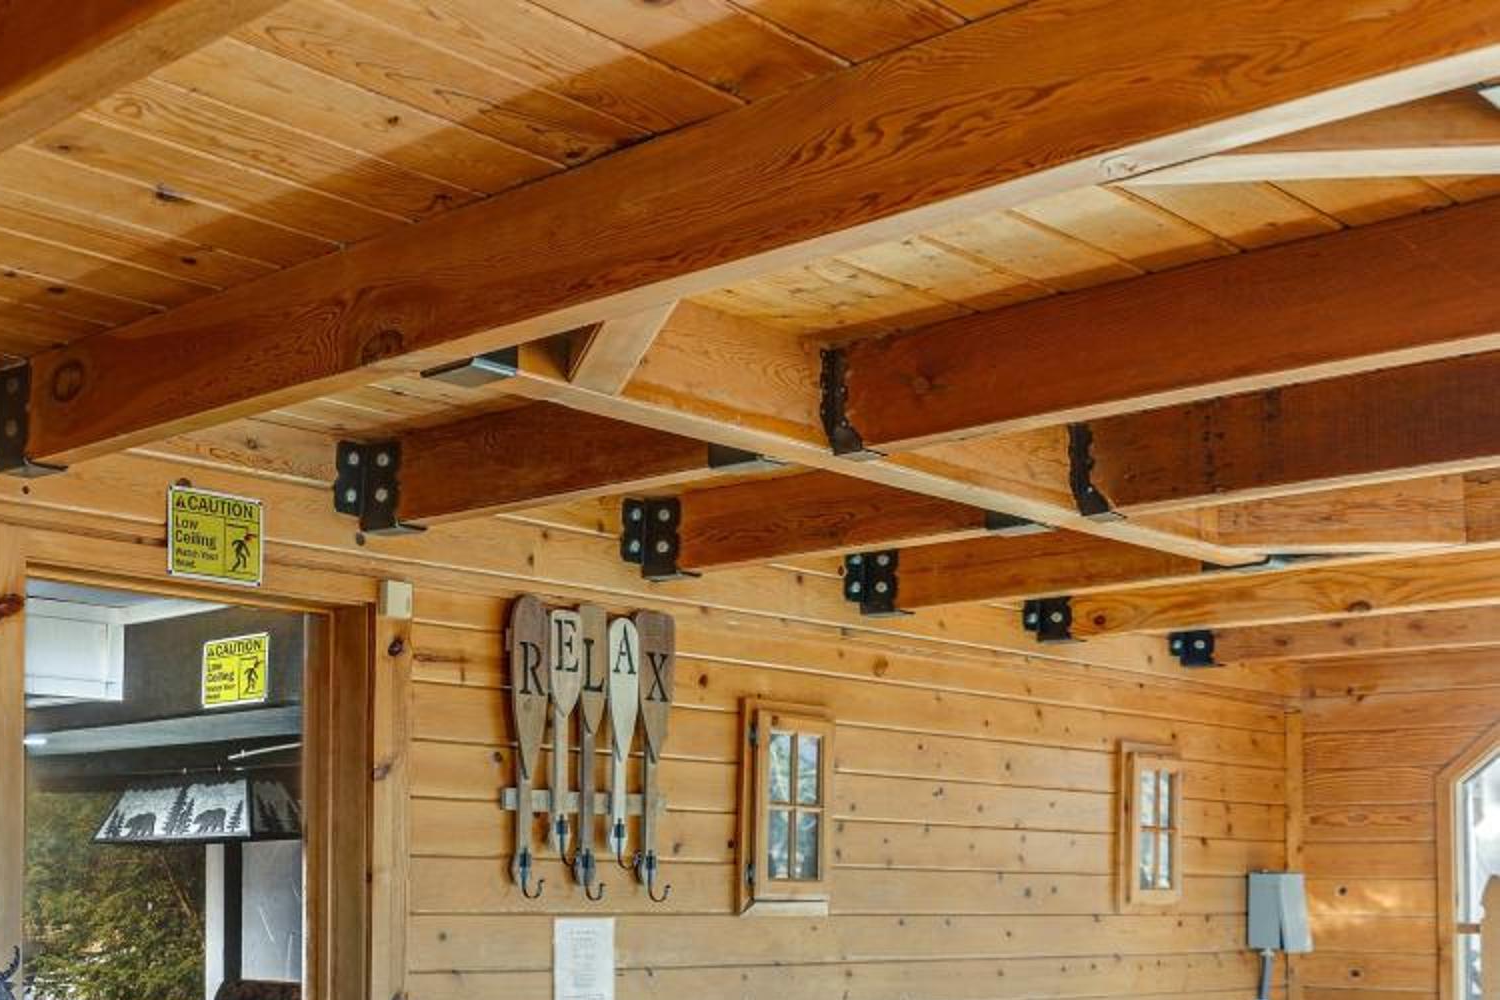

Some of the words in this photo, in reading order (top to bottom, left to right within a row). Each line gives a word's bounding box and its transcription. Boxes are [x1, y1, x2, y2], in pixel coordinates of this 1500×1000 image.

[187, 495, 253, 519] CAUTION
[175, 515, 199, 530] Low
[175, 529, 217, 550] Ceiling
[215, 640, 261, 657] CAUTION
[518, 618, 669, 703] RELAX
